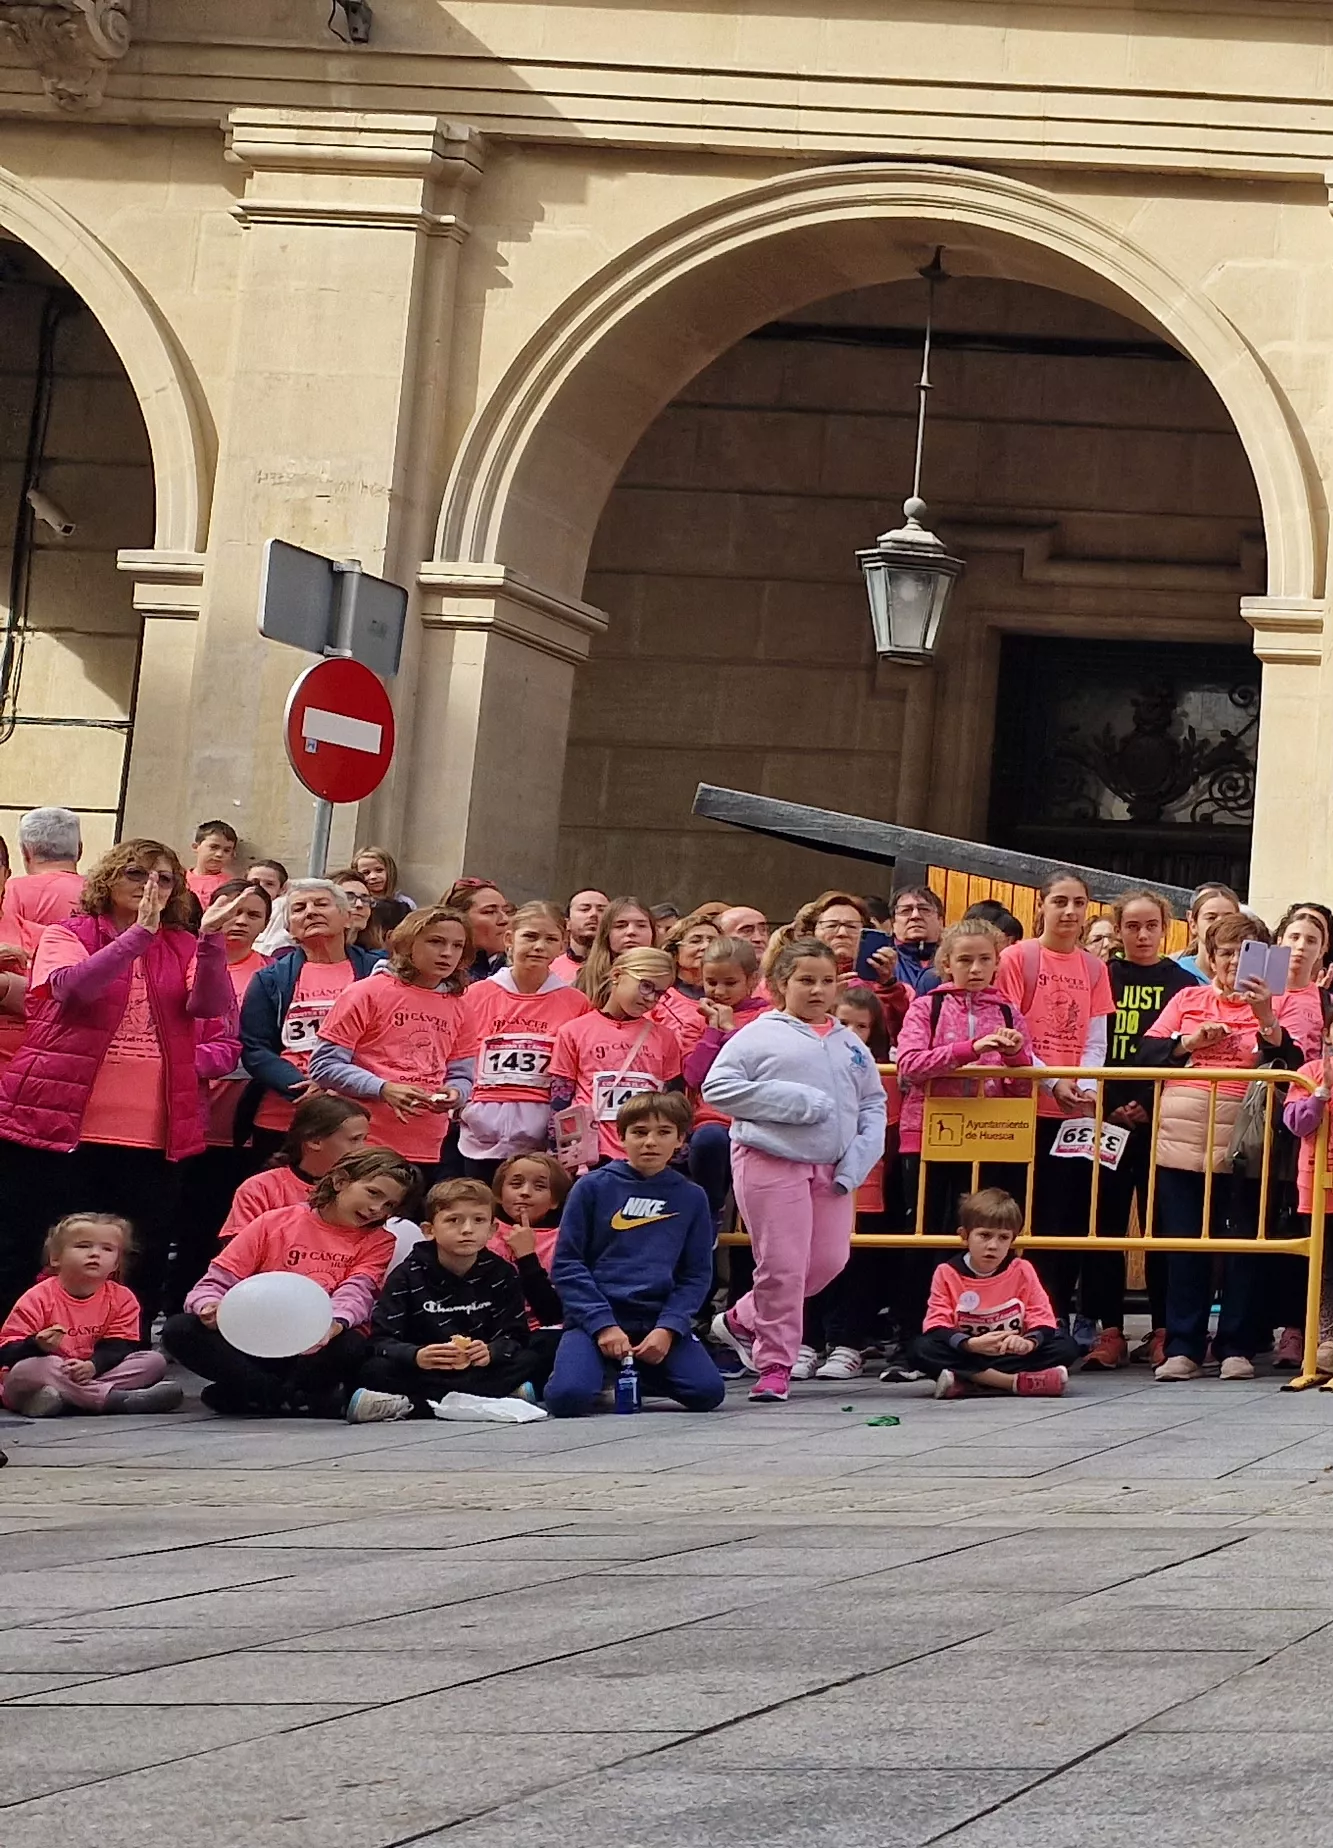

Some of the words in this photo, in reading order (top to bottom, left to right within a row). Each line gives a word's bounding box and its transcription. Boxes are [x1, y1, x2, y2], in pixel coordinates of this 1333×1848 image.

[1117, 985, 1164, 1010] JUST
[1114, 1009, 1140, 1034] DO
[489, 1052, 551, 1073] 1437
[965, 1120, 1030, 1130] Ayuntamiento
[965, 1131, 977, 1140] de
[979, 1131, 1014, 1140] Huesca
[622, 1197, 667, 1217] NIKE
[423, 1301, 491, 1315] Champion
